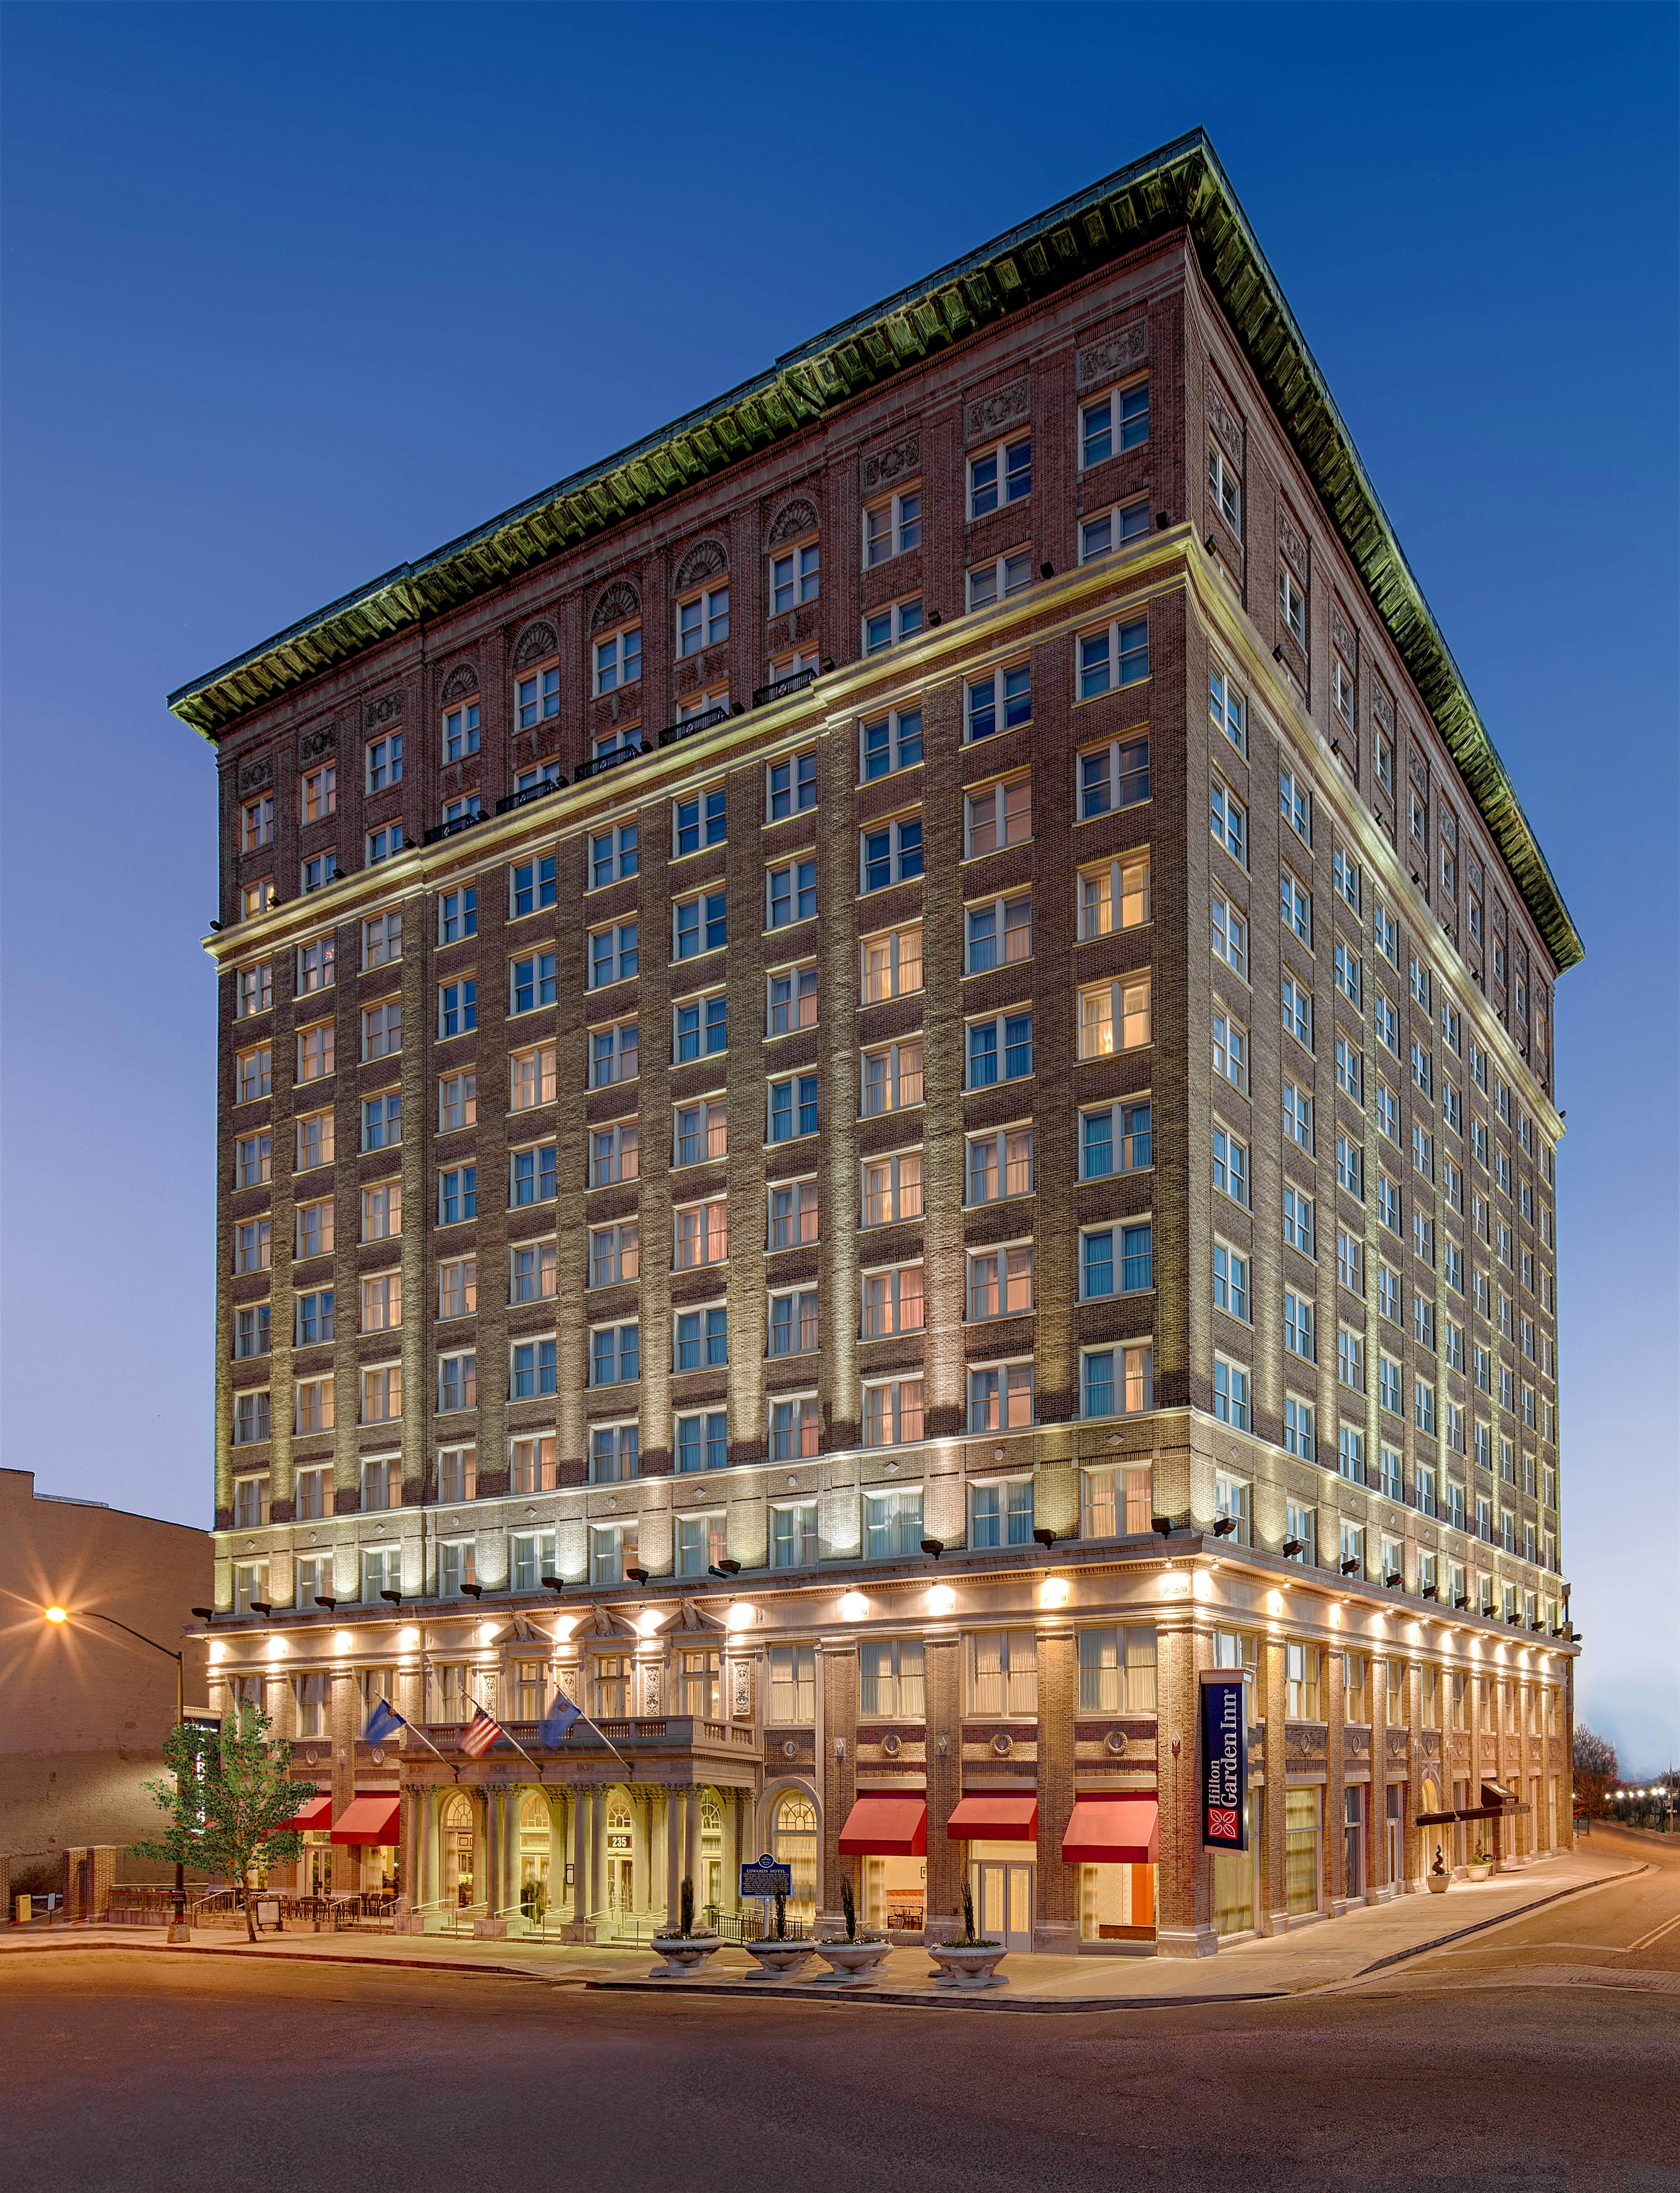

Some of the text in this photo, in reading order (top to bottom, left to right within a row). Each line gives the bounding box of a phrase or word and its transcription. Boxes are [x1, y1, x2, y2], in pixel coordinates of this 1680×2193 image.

[1209, 1760, 1220, 1805] Hilton
[1221, 1732, 1237, 1807] Garden
[282, 1821, 296, 1829] BAR
[612, 1837, 627, 1847] 235
